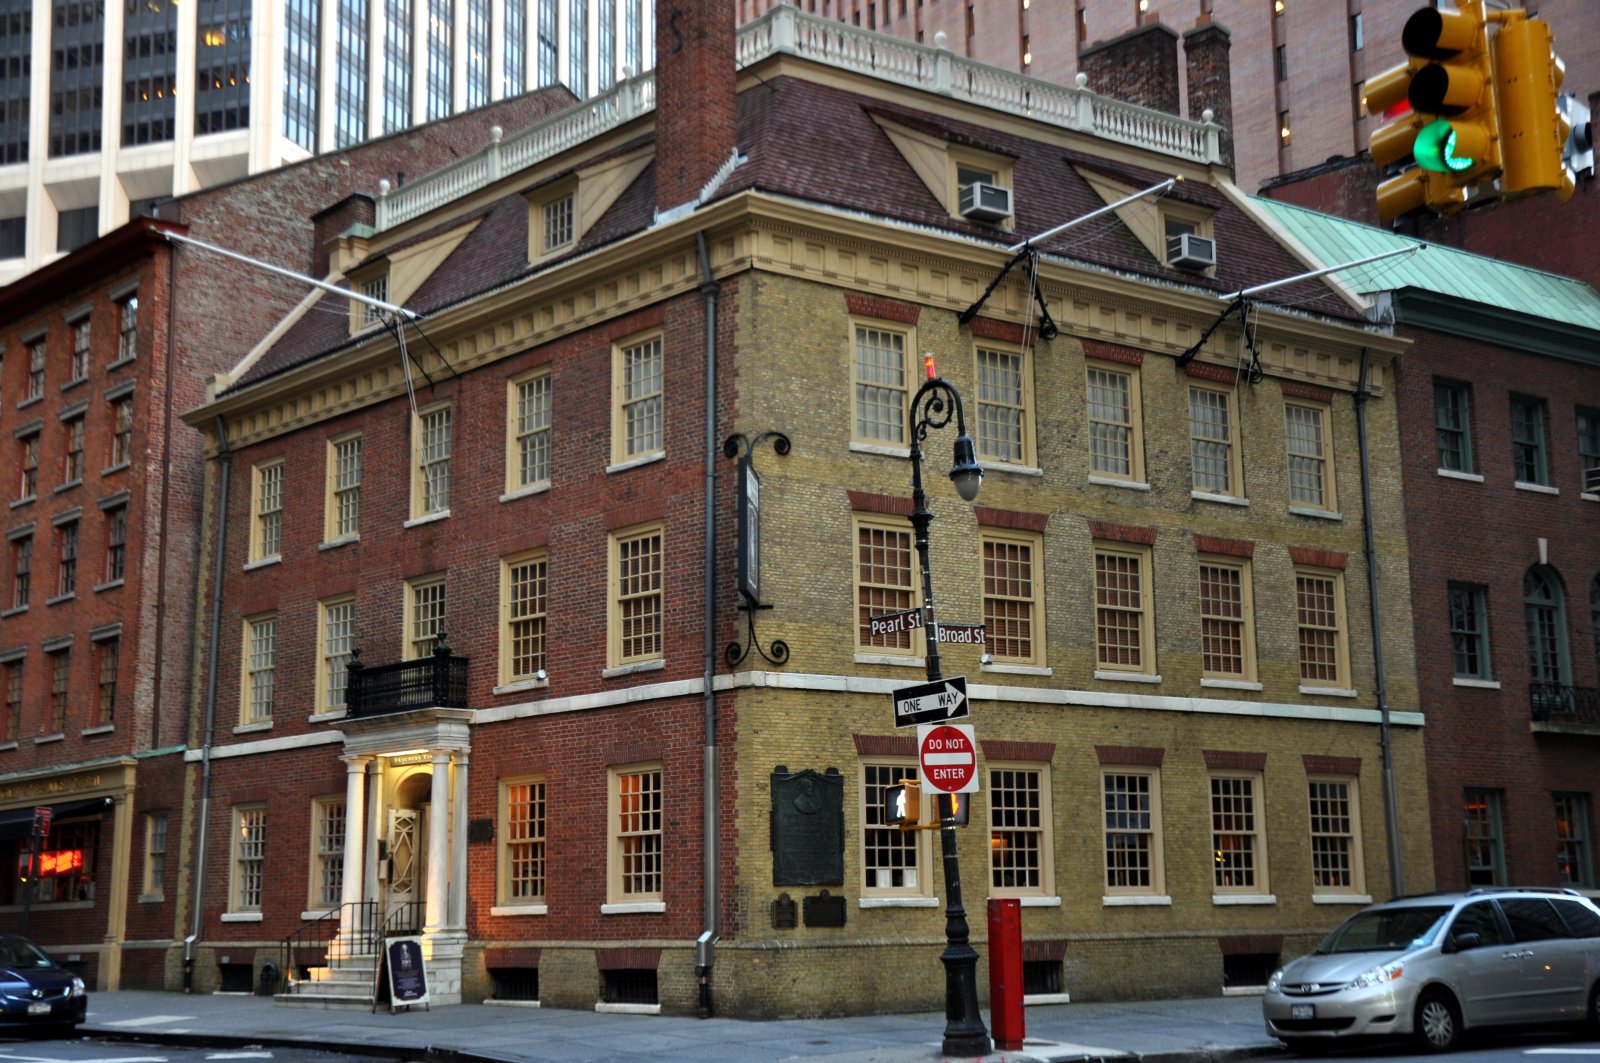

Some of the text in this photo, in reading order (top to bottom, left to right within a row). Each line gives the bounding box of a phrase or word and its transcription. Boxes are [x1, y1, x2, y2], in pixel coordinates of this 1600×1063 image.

[871, 612, 921, 635] Pearl St
[938, 627, 986, 643] Broad St
[903, 691, 959, 713] ONE WAY
[928, 738, 965, 750] DO NOT
[933, 768, 965, 780] ENTER
